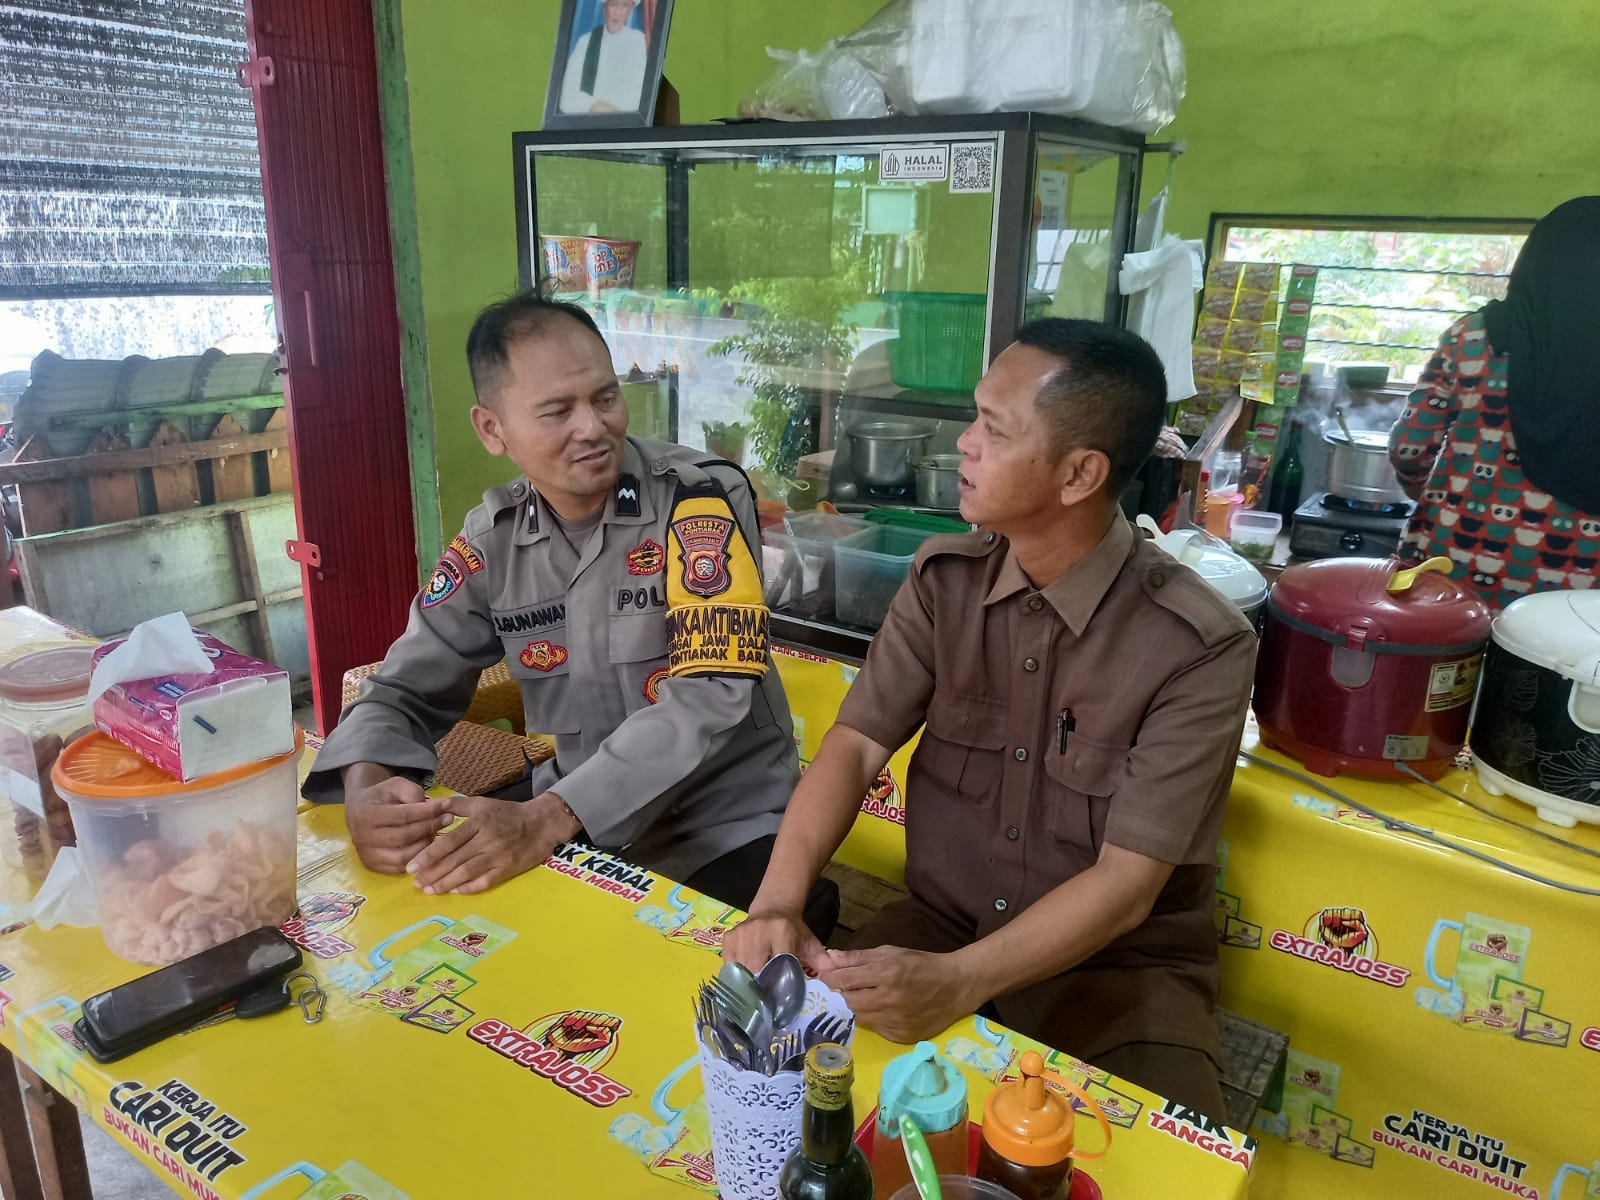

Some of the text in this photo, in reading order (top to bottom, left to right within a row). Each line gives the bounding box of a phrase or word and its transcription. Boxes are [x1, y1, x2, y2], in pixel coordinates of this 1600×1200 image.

[905, 155, 943, 165] HALAL
[680, 520, 724, 532] POLRESTA
[618, 585, 665, 611] POL
[700, 635, 729, 648] JAWI
[799, 651, 828, 664] SELFIE
[580, 856, 655, 892] KENAL
[585, 874, 645, 902] MERAH
[1271, 931, 1408, 984] EXTRAJOSS
[472, 1019, 628, 1104] EXTRAJOSS
[110, 1082, 246, 1182] CARI DUIT
[157, 1080, 247, 1139] KERJA ITU
[1413, 1110, 1503, 1152] KERJA ITU
[104, 1106, 150, 1154] BUKAN
[153, 1145, 184, 1182] CARI
[1150, 1112, 1250, 1170] TANGGA
[1385, 1115, 1527, 1178] CARI DUIT
[1372, 1130, 1540, 1200] BUKAN CARI MUKA
